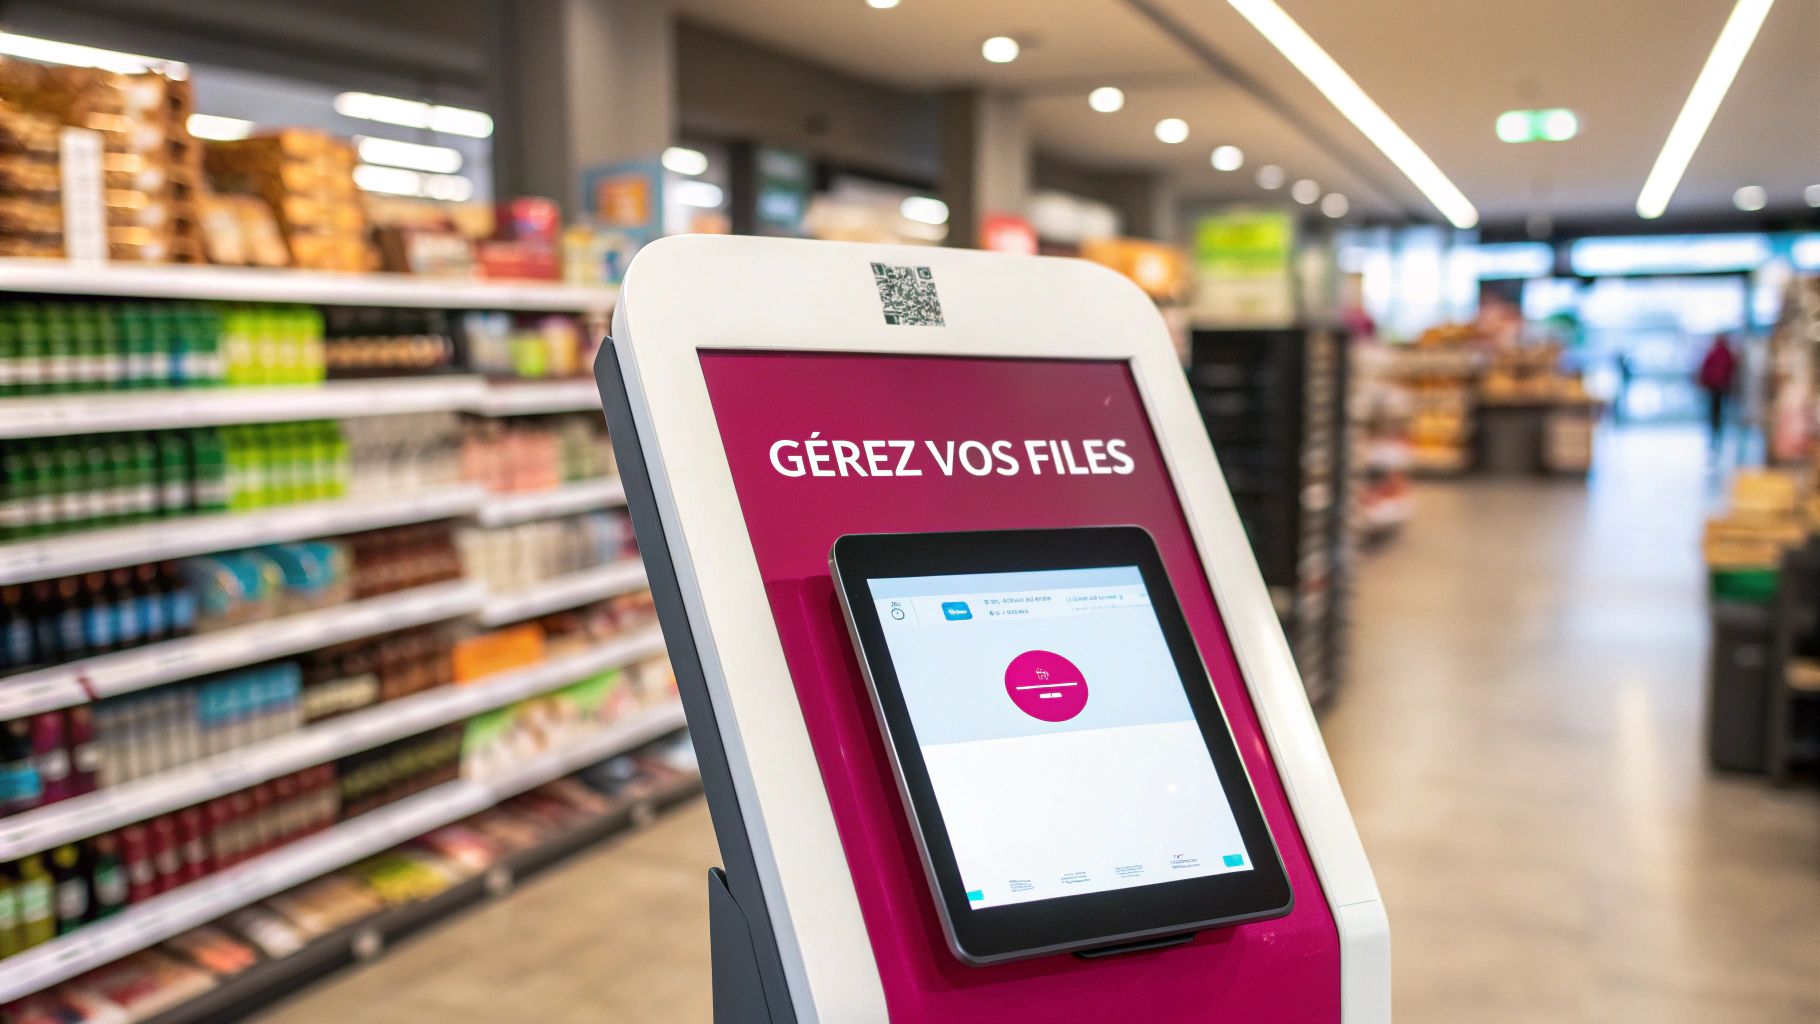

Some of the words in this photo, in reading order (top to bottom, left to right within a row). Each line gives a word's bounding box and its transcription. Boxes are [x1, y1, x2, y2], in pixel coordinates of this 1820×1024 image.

[769, 431, 923, 478] GÉREZ
[924, 440, 1020, 477] VOS
[1023, 438, 1135, 476] FILES
